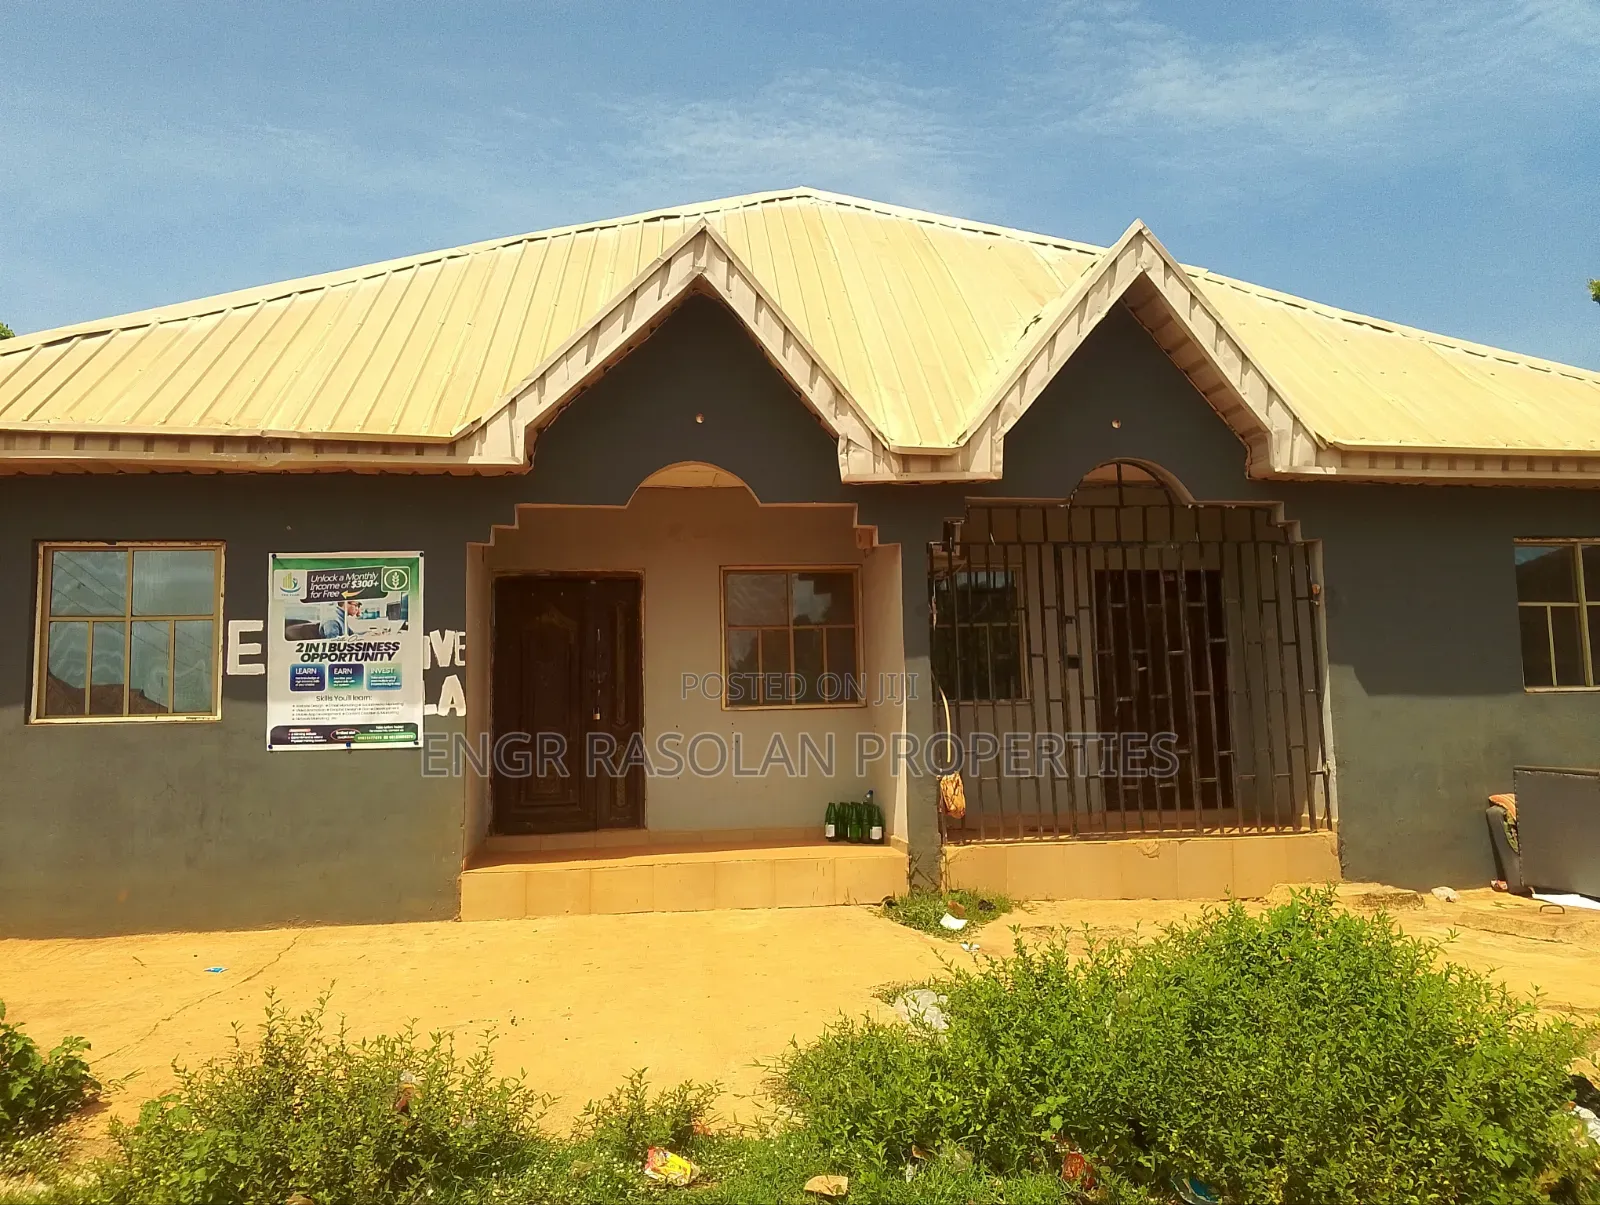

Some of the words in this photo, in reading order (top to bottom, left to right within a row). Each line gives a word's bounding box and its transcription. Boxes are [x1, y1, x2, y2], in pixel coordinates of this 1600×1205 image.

[310, 574, 338, 583] Unlock
[346, 572, 379, 582] Monthly
[310, 582, 340, 591] Income
[340, 581, 351, 589] of
[351, 580, 379, 589] $300+
[310, 590, 322, 599] for
[323, 590, 340, 598] Free
[295, 642, 305, 652] 2
[305, 642, 320, 652] IN
[322, 642, 328, 652] 1
[328, 642, 400, 652] BUSSINESS
[300, 652, 396, 662] OPPORTUNITY
